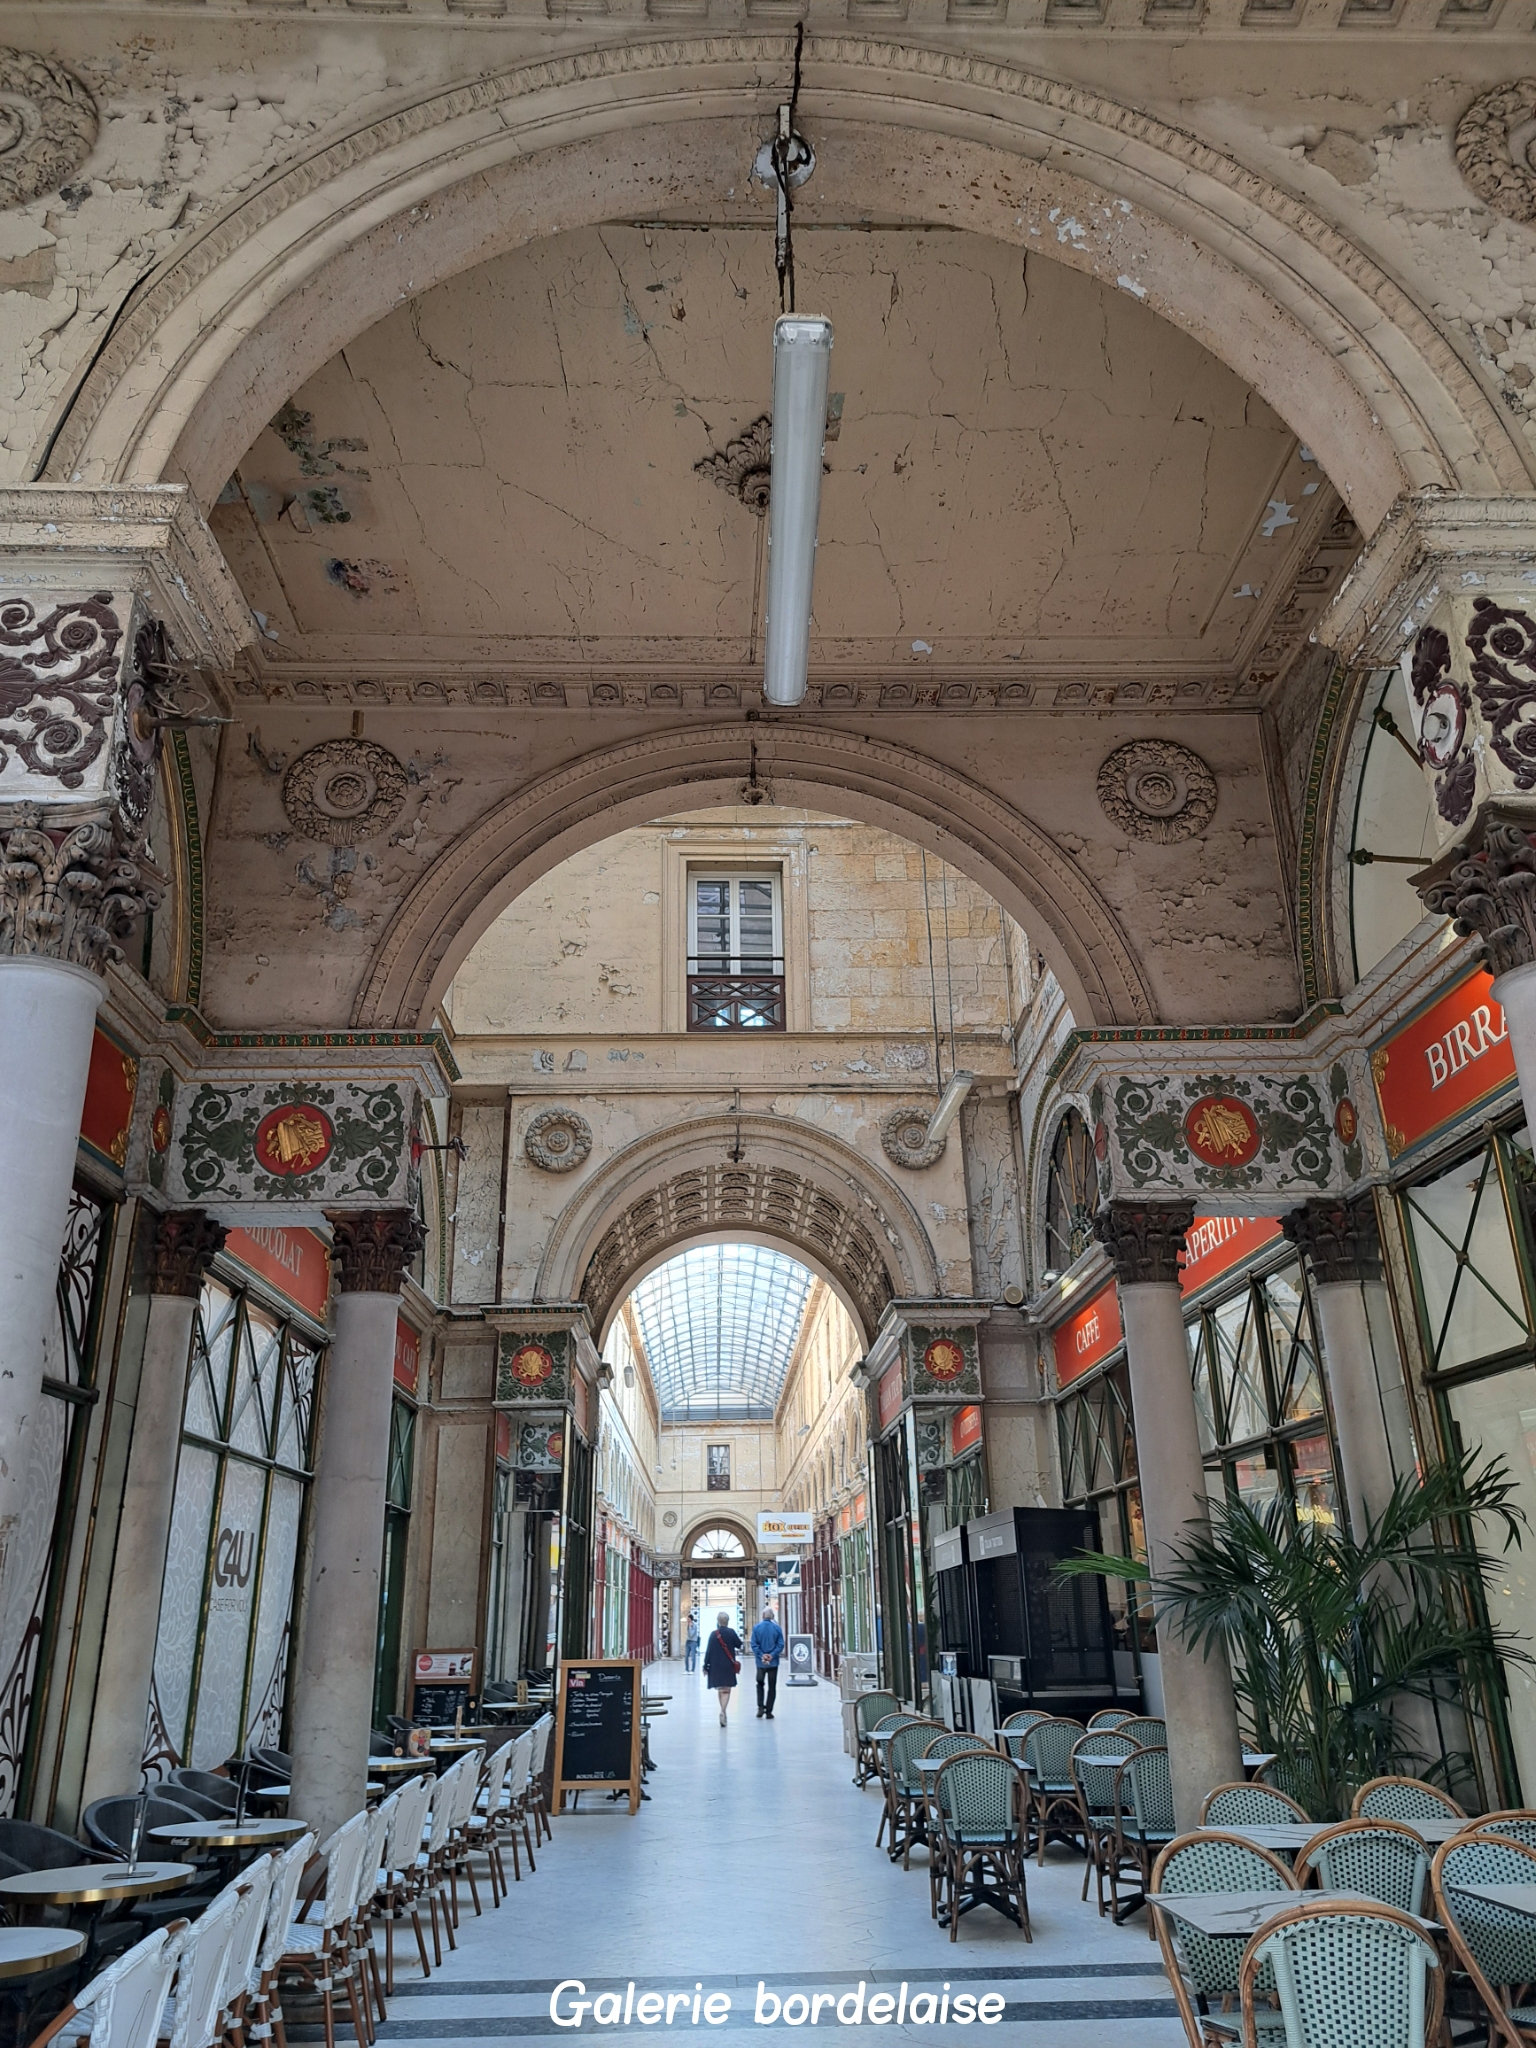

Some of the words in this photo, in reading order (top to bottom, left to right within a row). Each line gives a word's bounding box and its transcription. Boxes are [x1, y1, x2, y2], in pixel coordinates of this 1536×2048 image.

[244, 1226, 304, 1278] HOCOLAT
[1076, 1310, 1100, 1354] CAFFÈ
[762, 1521, 786, 1533] BOX
[214, 1527, 254, 1588] C4U
[224, 1598, 235, 1612] FOR
[569, 1679, 584, 1687] Vin
